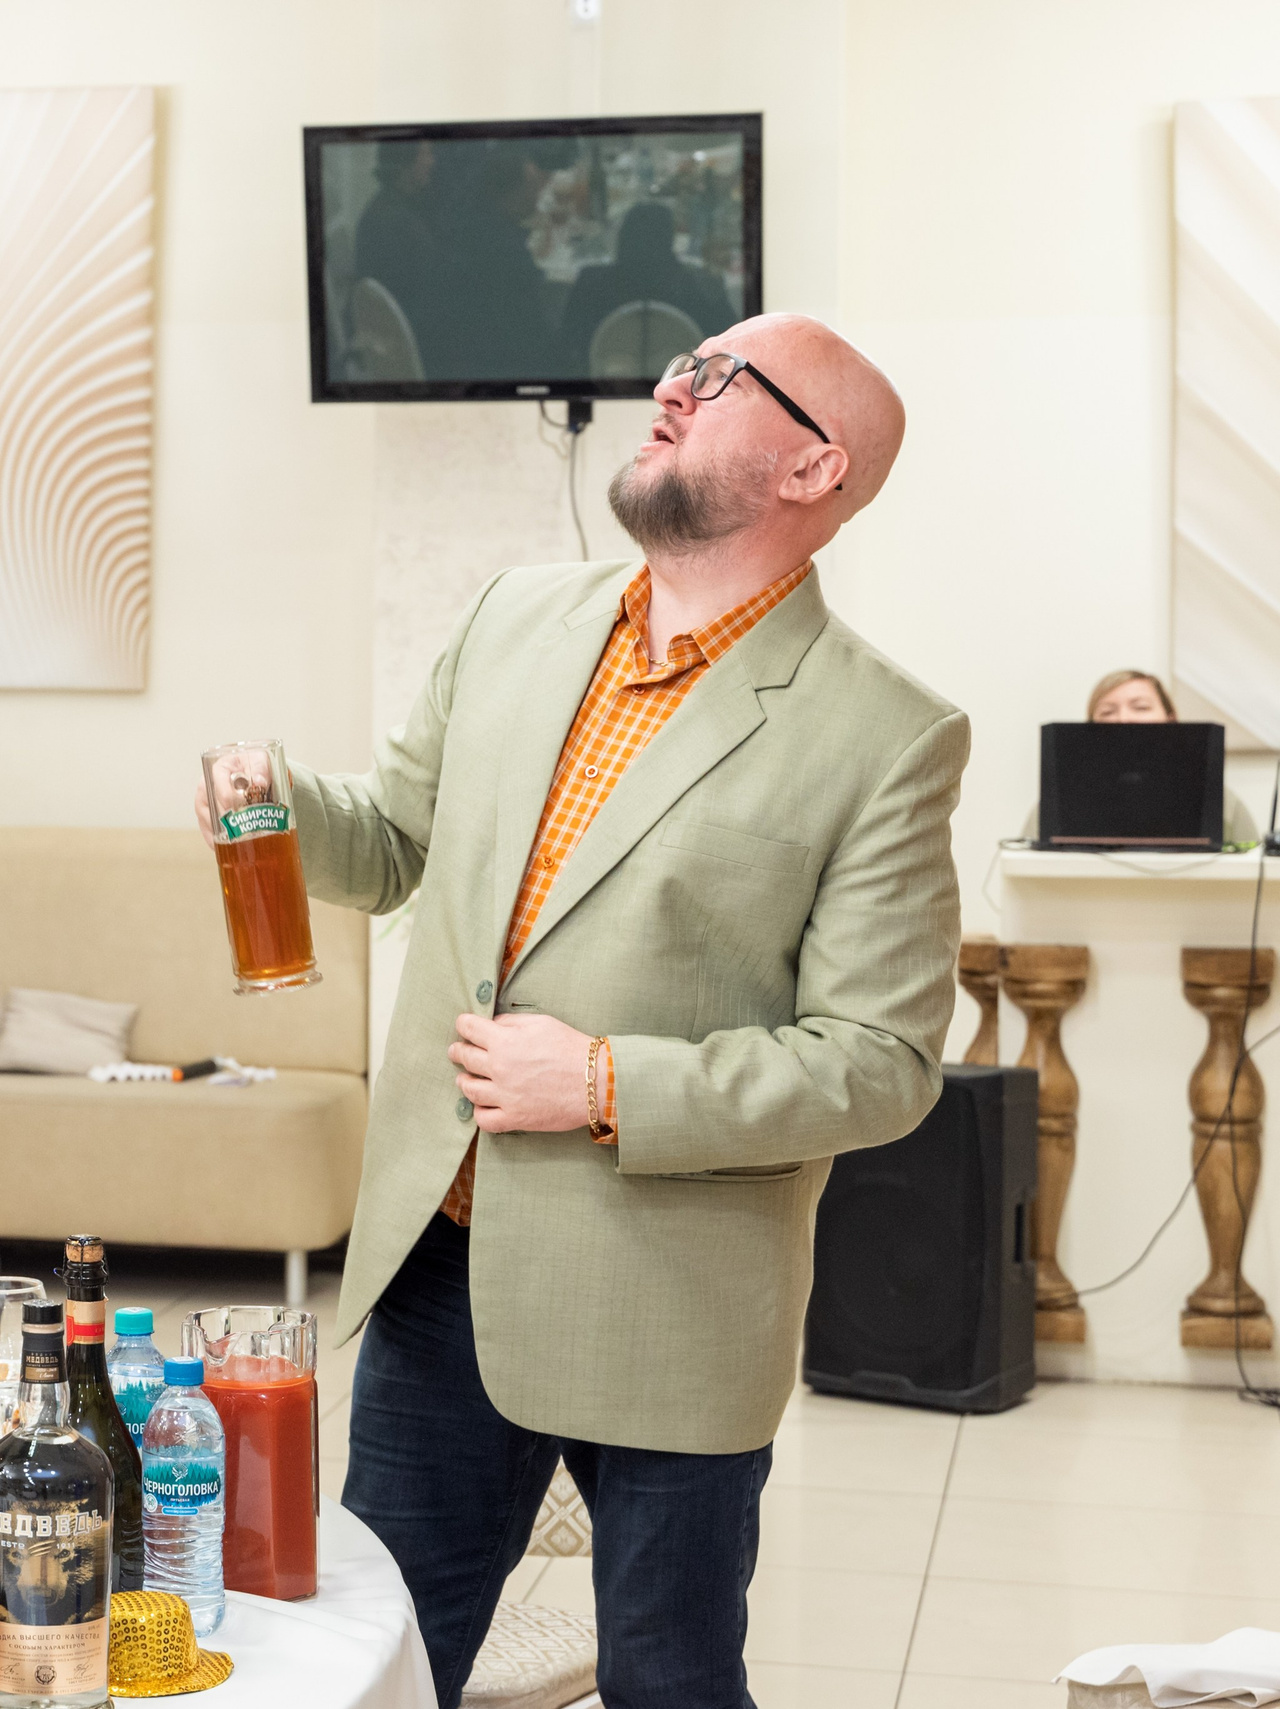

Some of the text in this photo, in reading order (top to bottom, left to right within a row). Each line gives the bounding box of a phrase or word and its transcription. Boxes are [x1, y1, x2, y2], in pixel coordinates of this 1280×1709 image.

[229, 808, 284, 827] СИБИРСКАЯ
[240, 819, 278, 833] КОРОНА
[144, 1477, 219, 1496] ЧЕРНОГОЛОВКА
[64, 1633, 100, 1641] КАЧЕСТВА
